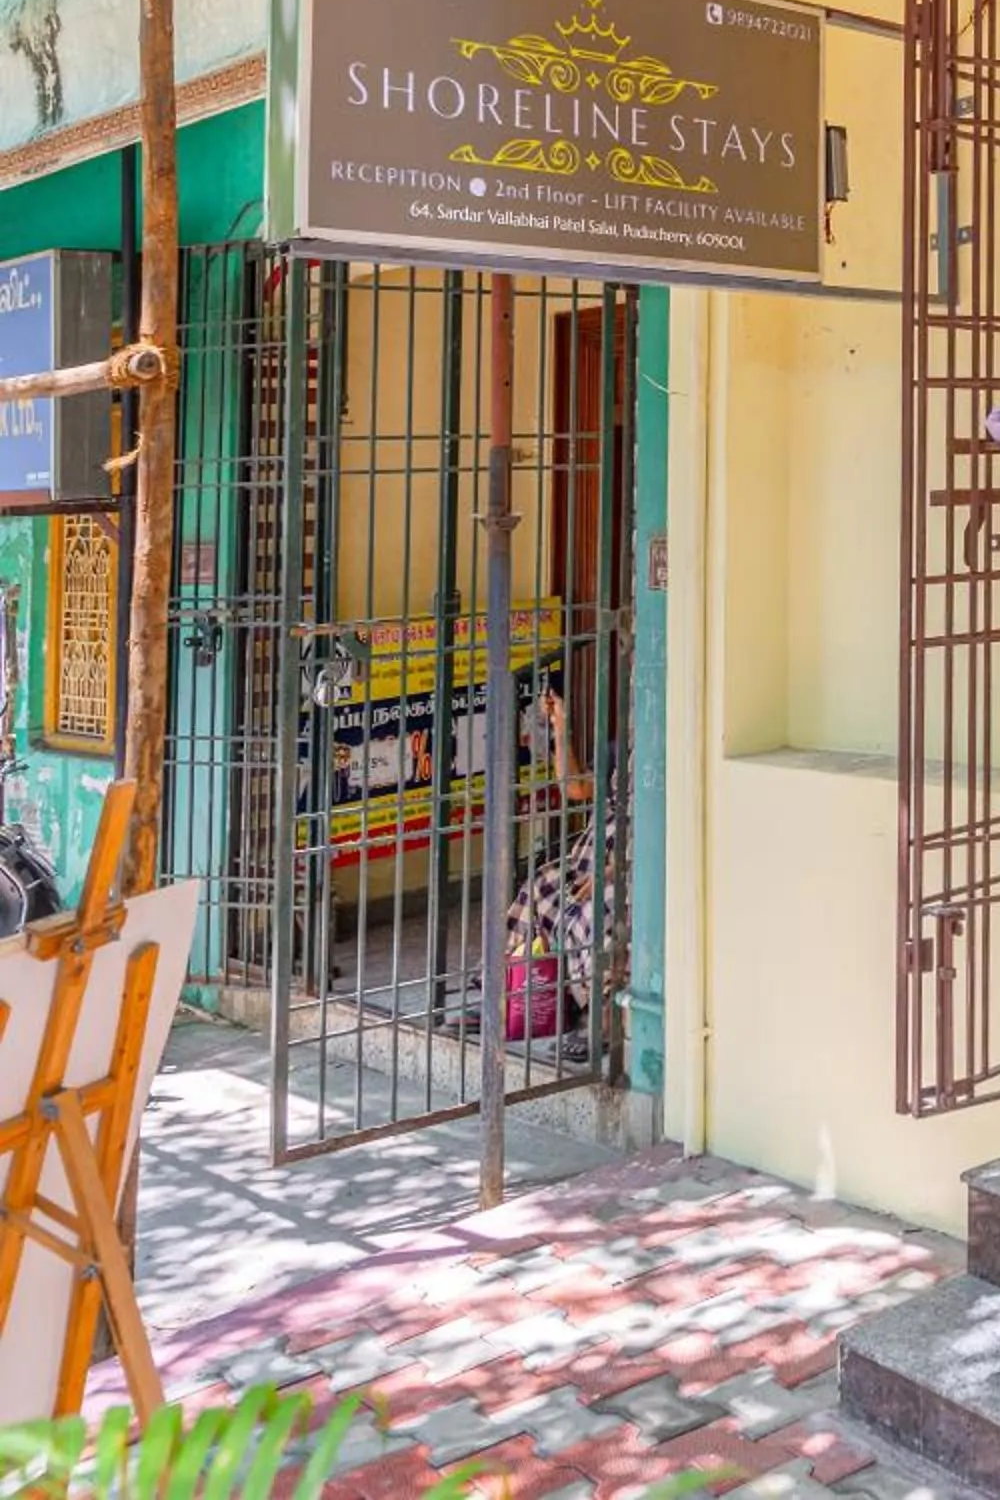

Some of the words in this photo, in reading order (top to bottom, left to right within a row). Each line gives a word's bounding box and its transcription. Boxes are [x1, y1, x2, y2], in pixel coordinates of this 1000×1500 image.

[347, 62, 649, 148] SHORELINE
[669, 115, 796, 169] STAYS
[437, 203, 484, 223] Sardar
[487, 207, 549, 229] Vallabhai
[553, 215, 585, 233] Patel
[496, 178, 529, 201] 2nd
[537, 184, 585, 206] Floor
[604, 192, 638, 213] LIFT
[645, 196, 719, 220] FACILITY
[723, 207, 807, 231] AVAILABLE
